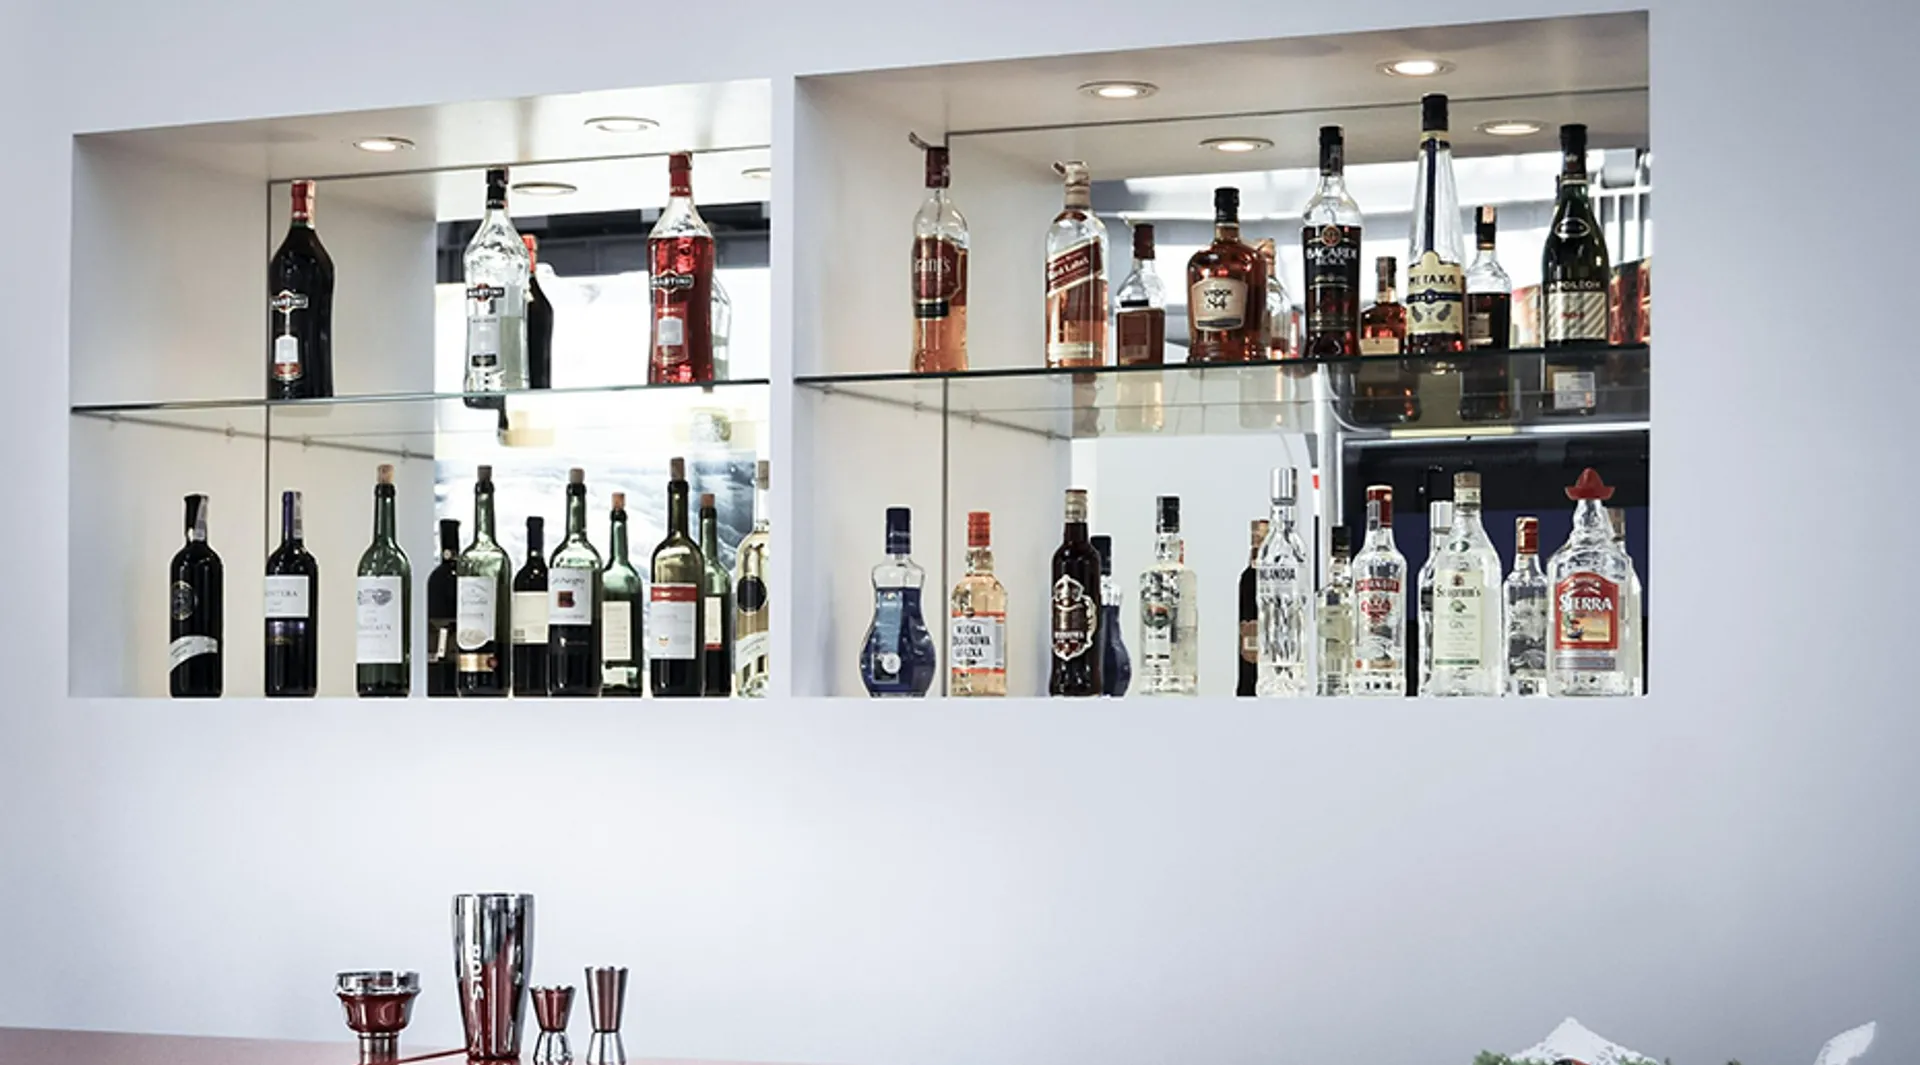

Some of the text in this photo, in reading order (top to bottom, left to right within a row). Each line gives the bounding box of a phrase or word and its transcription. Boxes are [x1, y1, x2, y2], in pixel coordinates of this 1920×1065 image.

[1306, 247, 1357, 259] BACARDI
[1408, 274, 1456, 286] METAXA
[1546, 280, 1601, 291] APOLEON
[1559, 594, 1614, 612] SIERRA
